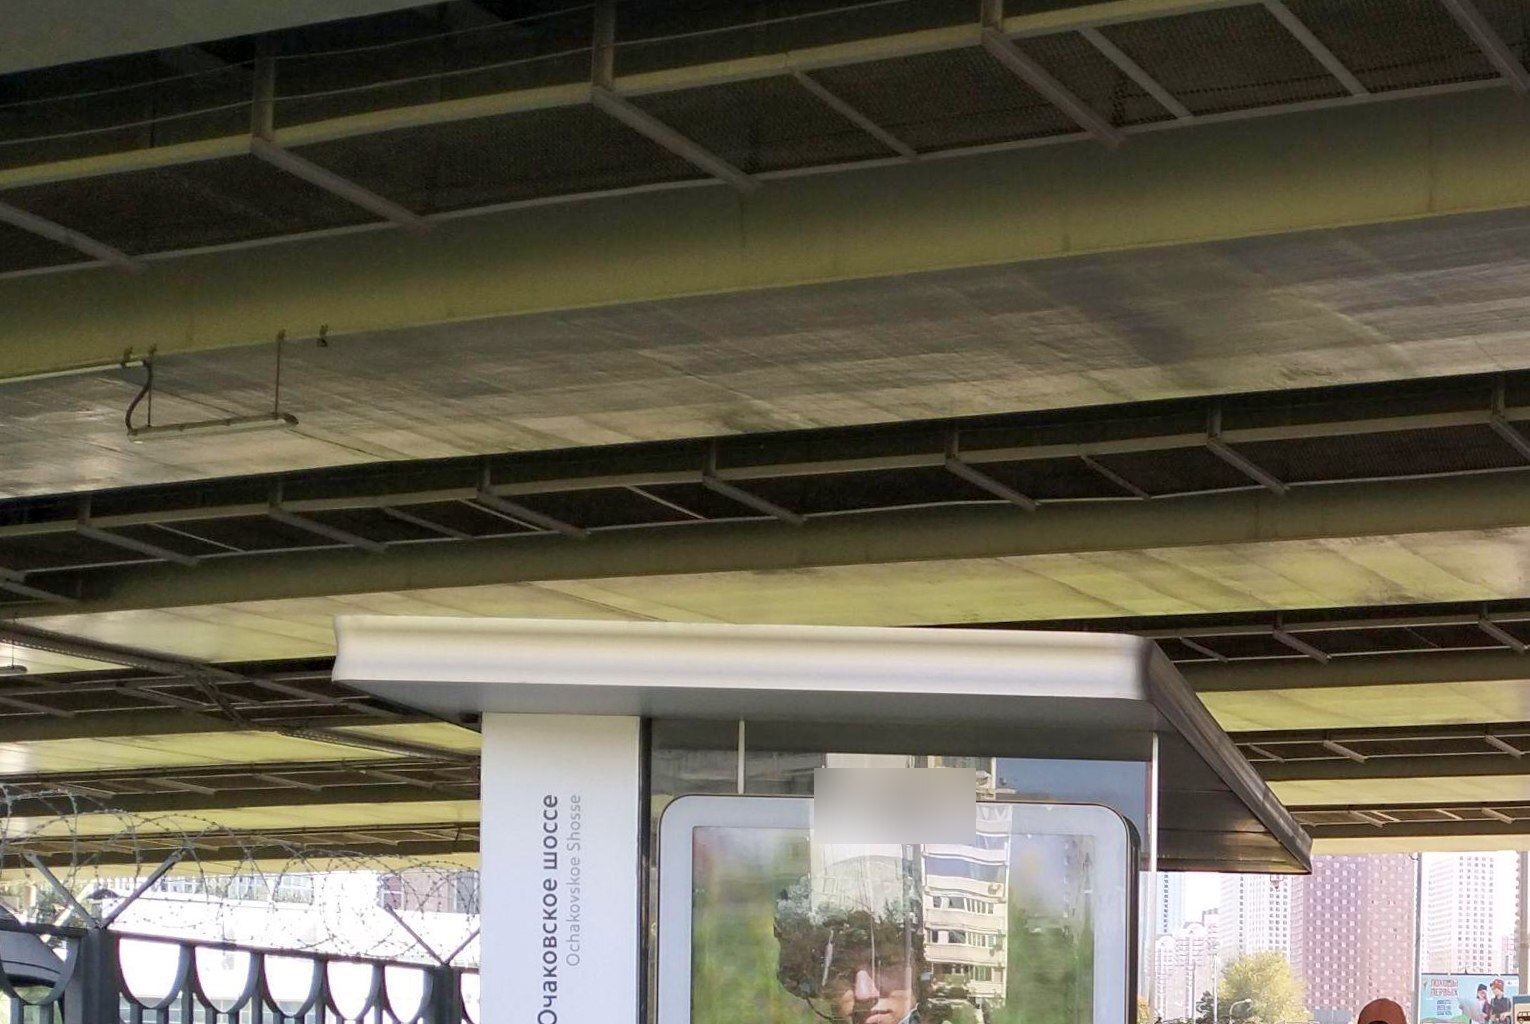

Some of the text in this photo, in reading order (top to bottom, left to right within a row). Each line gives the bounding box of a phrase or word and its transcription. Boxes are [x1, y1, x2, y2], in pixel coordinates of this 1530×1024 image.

[543, 794, 558, 870] шоссе
[566, 794, 581, 967] Ochakovskoe Shosse
